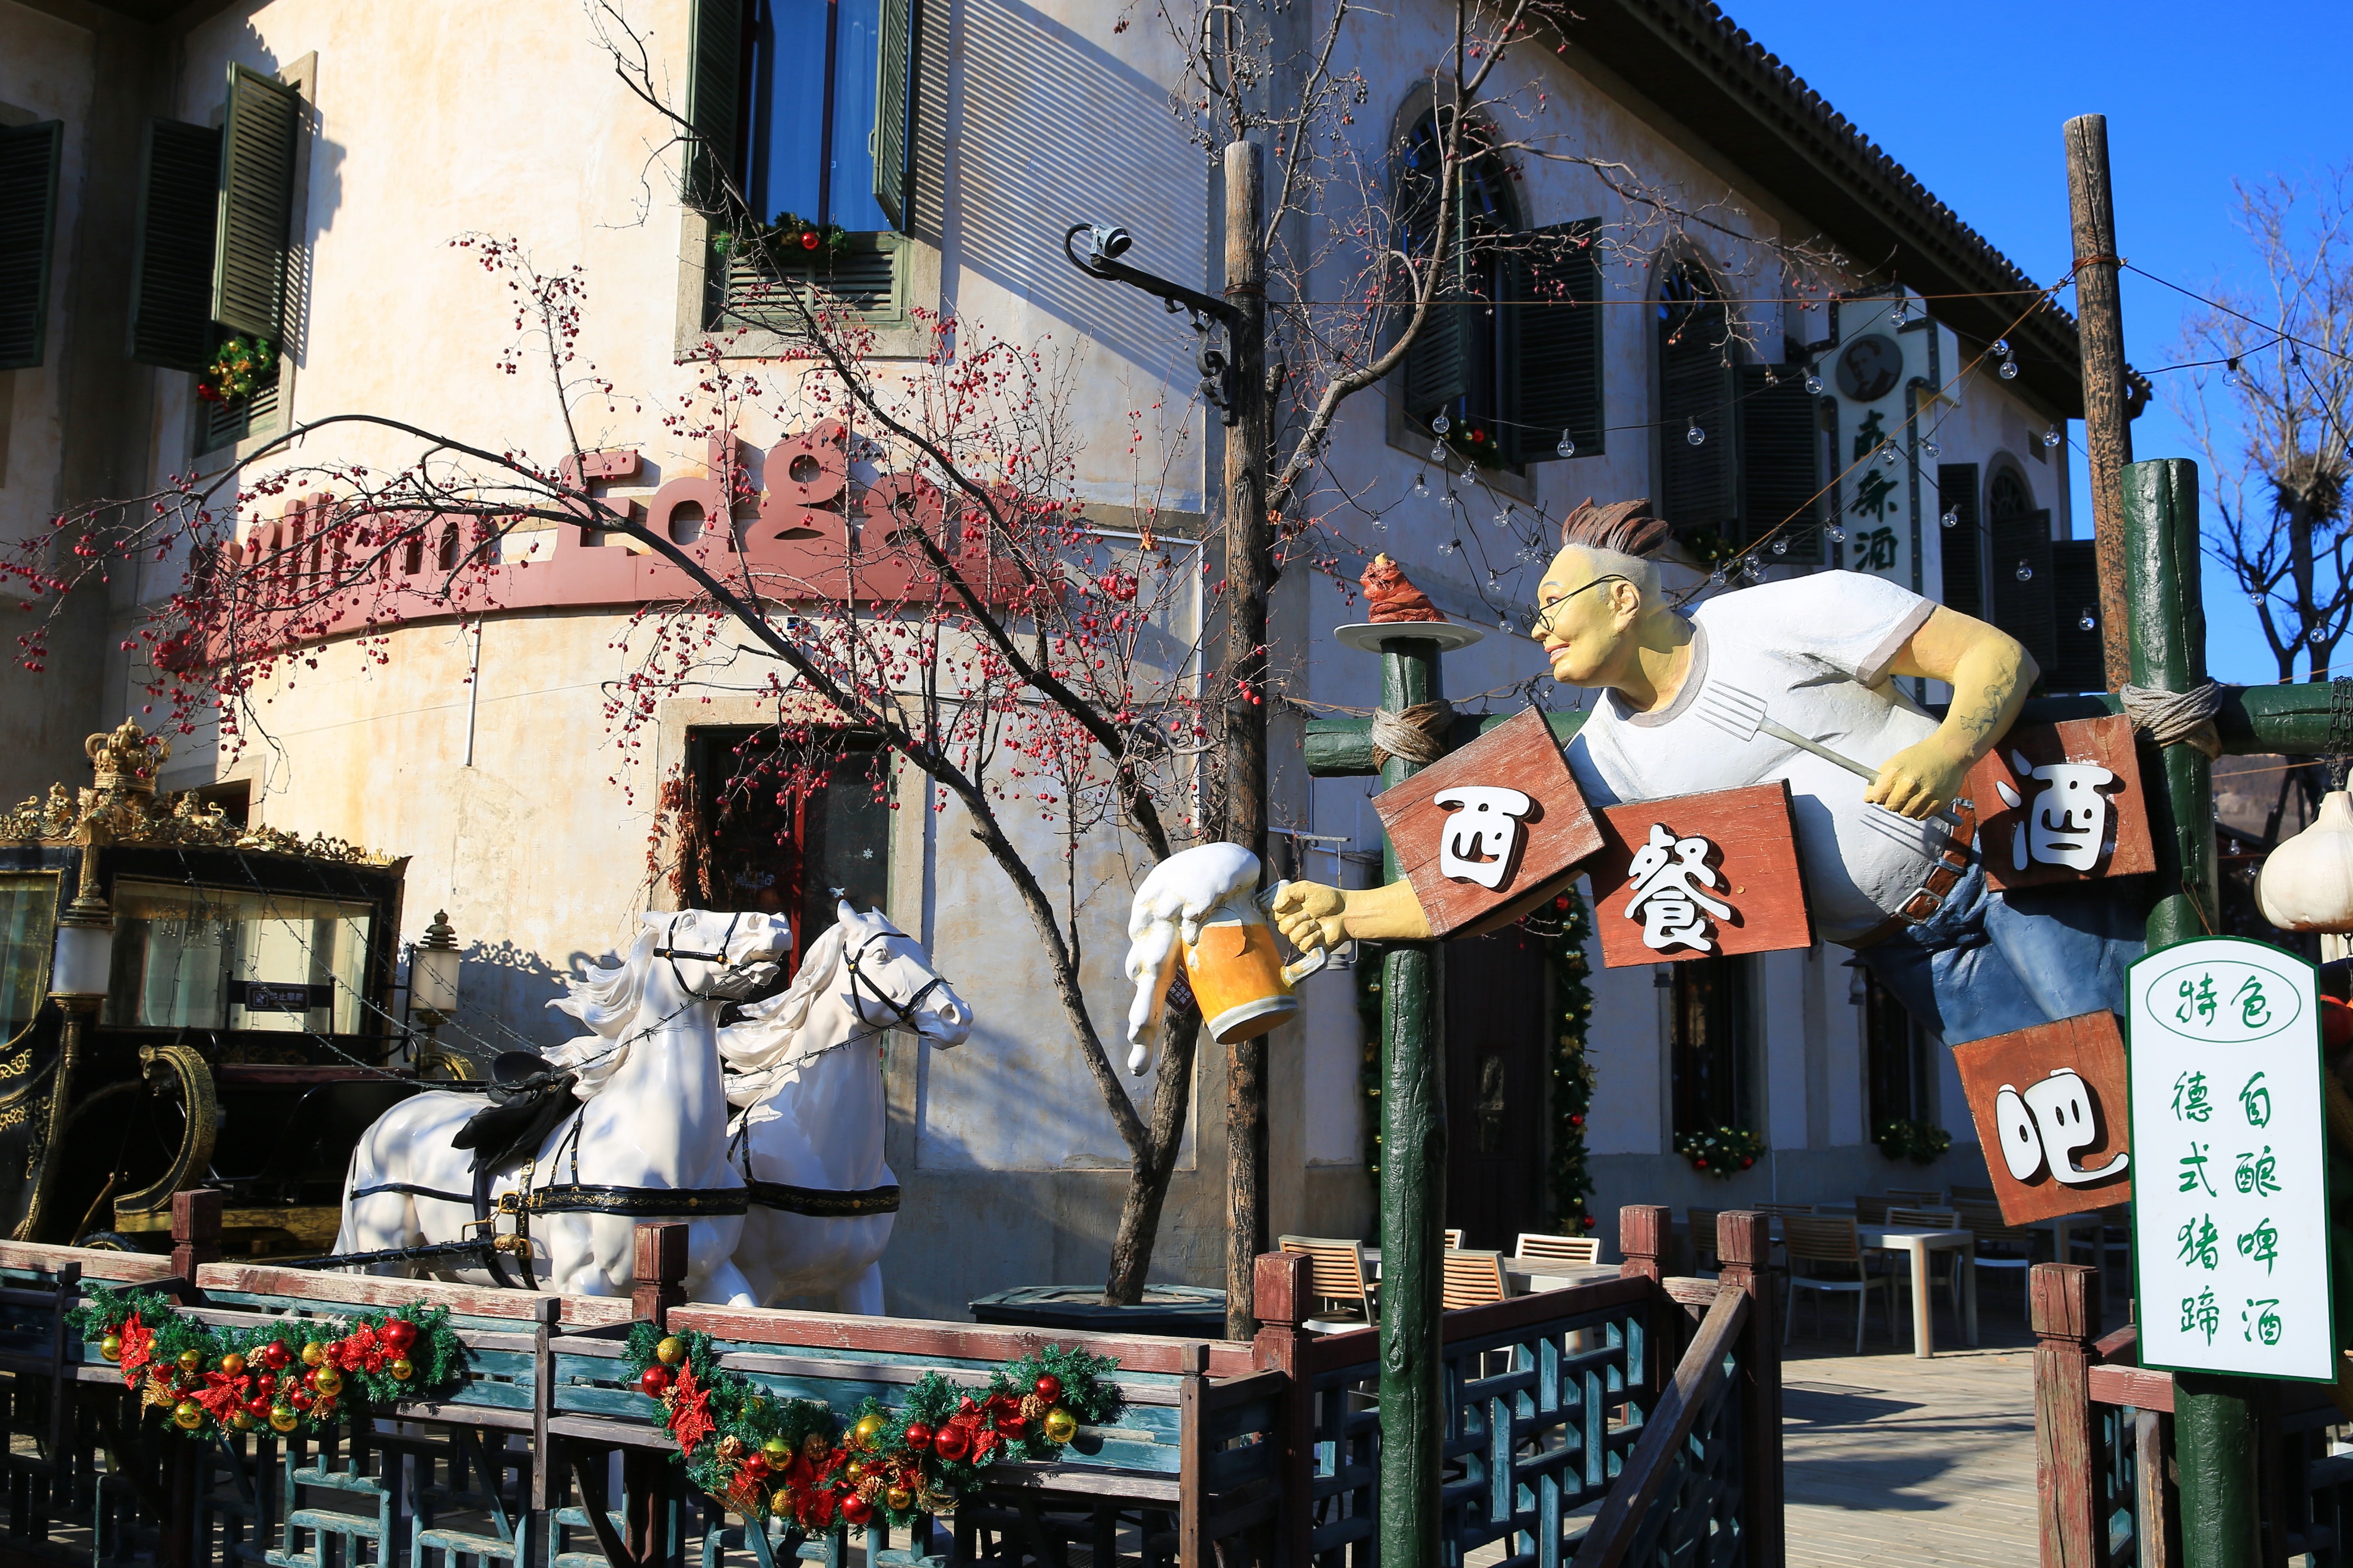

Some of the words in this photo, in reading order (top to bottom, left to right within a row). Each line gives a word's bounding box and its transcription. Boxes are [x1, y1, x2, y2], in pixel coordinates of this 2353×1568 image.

[557, 418, 1023, 559] Edgar
[1433, 785, 1530, 888] 西
[1996, 749, 2114, 872] 酒
[1624, 824, 1731, 951] 餐
[2175, 971, 2272, 1029] 特色
[1996, 1072, 2129, 1184] 吧
[2171, 1070, 2221, 1347] 德式猪蹄
[2234, 1071, 2283, 1346] 自酿啤酒
